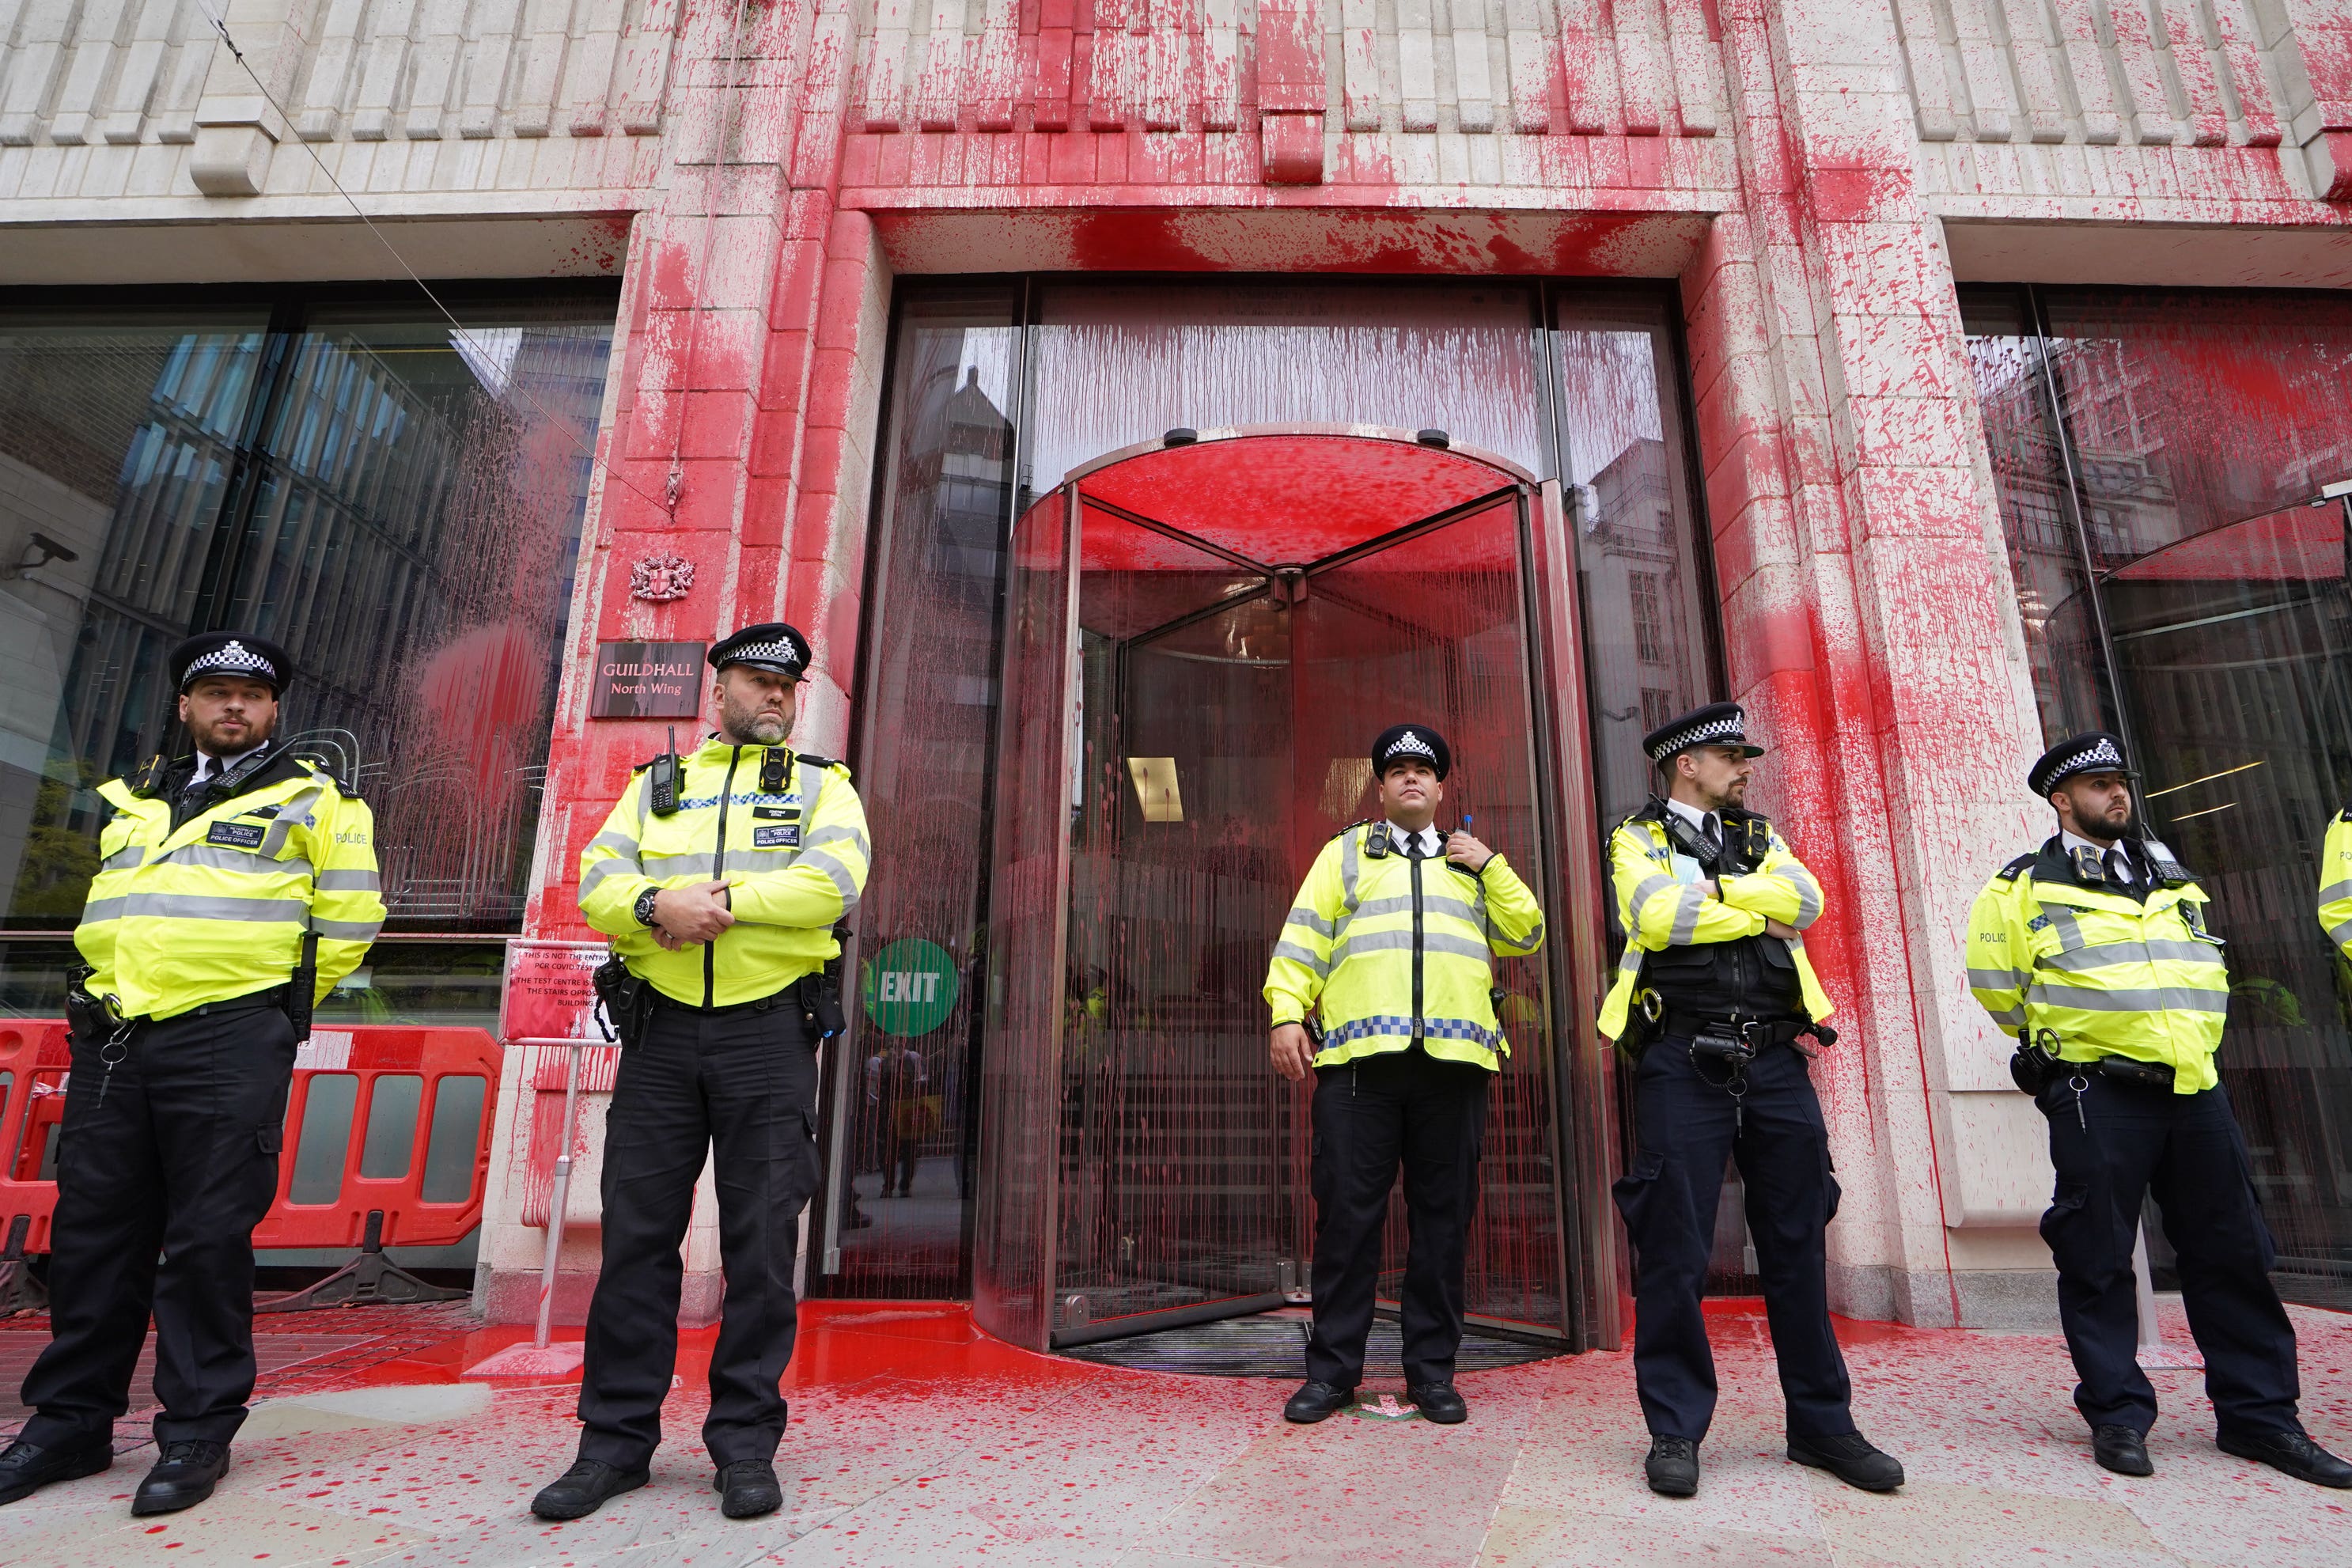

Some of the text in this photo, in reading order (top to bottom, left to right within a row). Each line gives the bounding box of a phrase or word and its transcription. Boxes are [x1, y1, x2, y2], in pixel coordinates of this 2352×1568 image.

[603, 664, 694, 676] GUILDHALL
[611, 683, 682, 695] North Wing
[335, 832, 367, 845] POLICE
[880, 971, 940, 1002] EXIT
